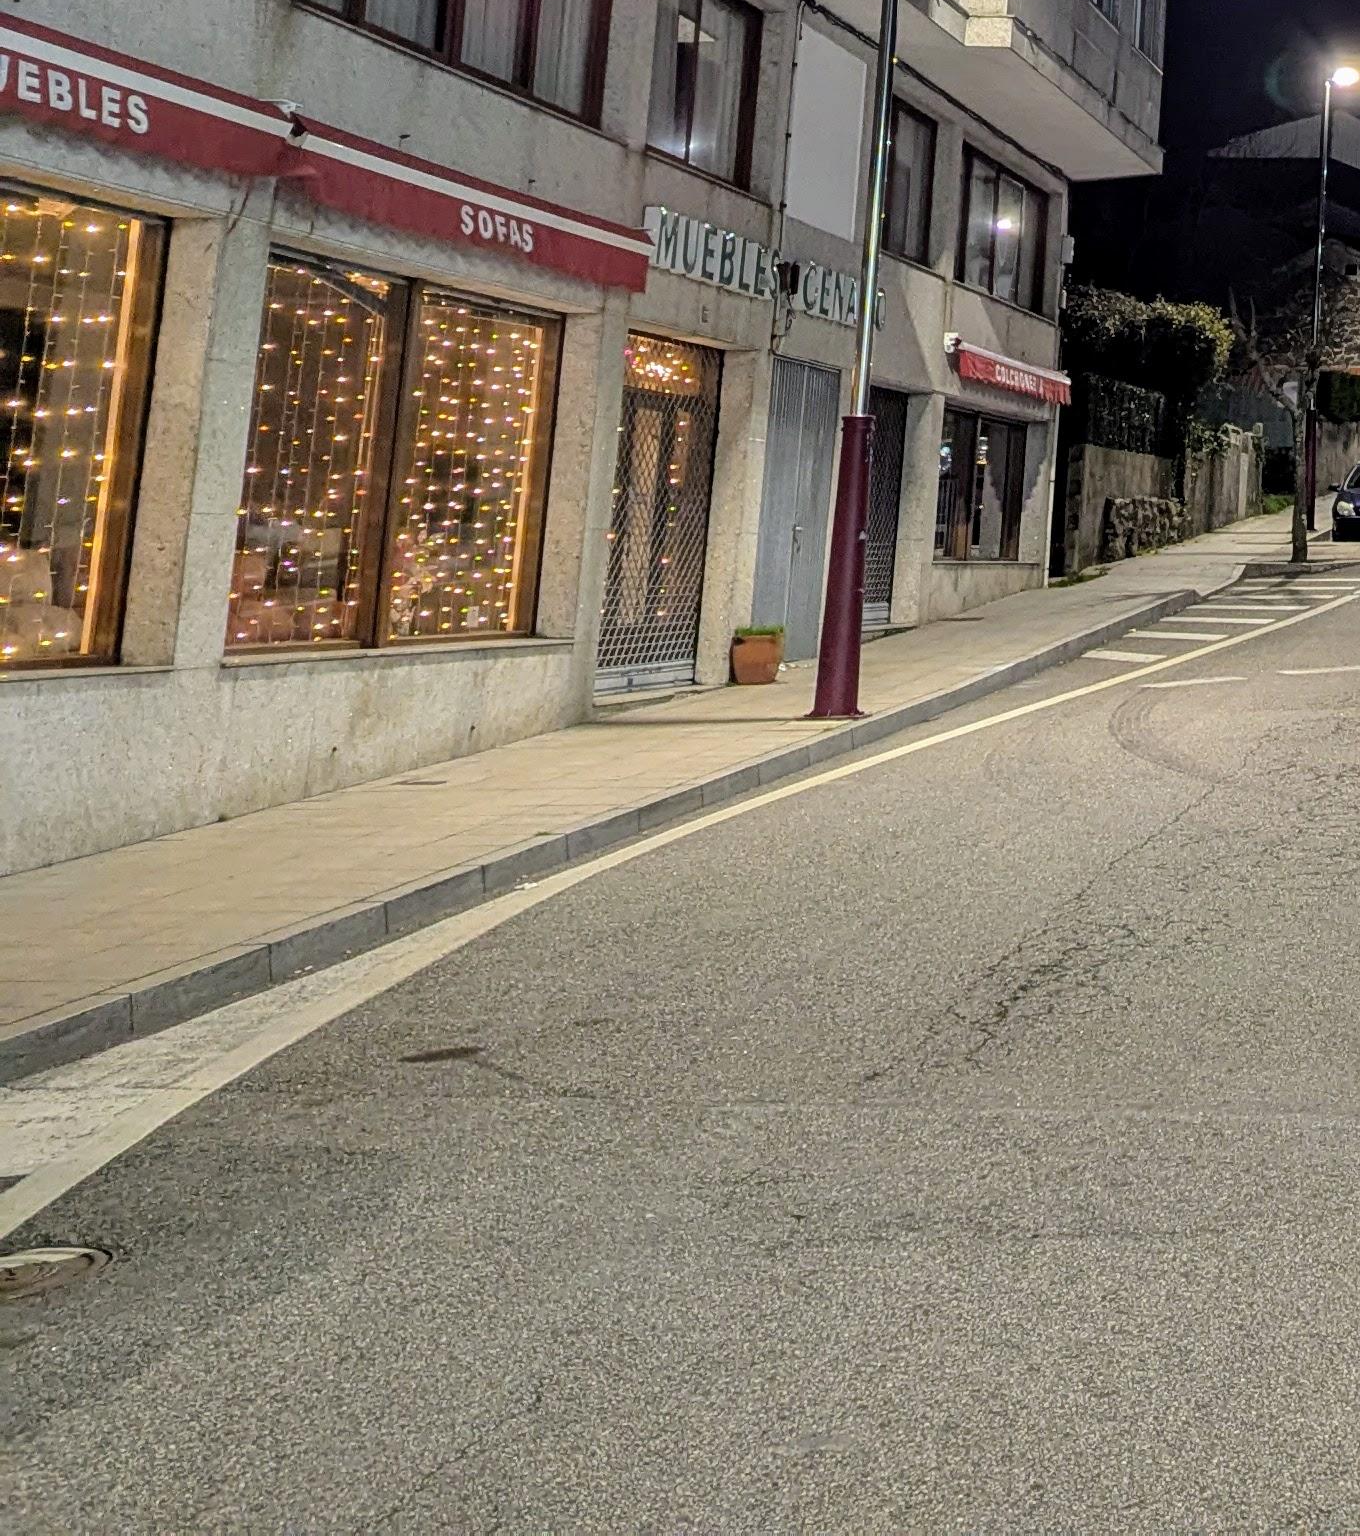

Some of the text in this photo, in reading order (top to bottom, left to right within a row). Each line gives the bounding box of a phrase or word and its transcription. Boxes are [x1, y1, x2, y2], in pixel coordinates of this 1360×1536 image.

[460, 204, 534, 253] SOFAS
[656, 210, 782, 300] MUEBLES
[995, 364, 1045, 396] COLCHONERA
